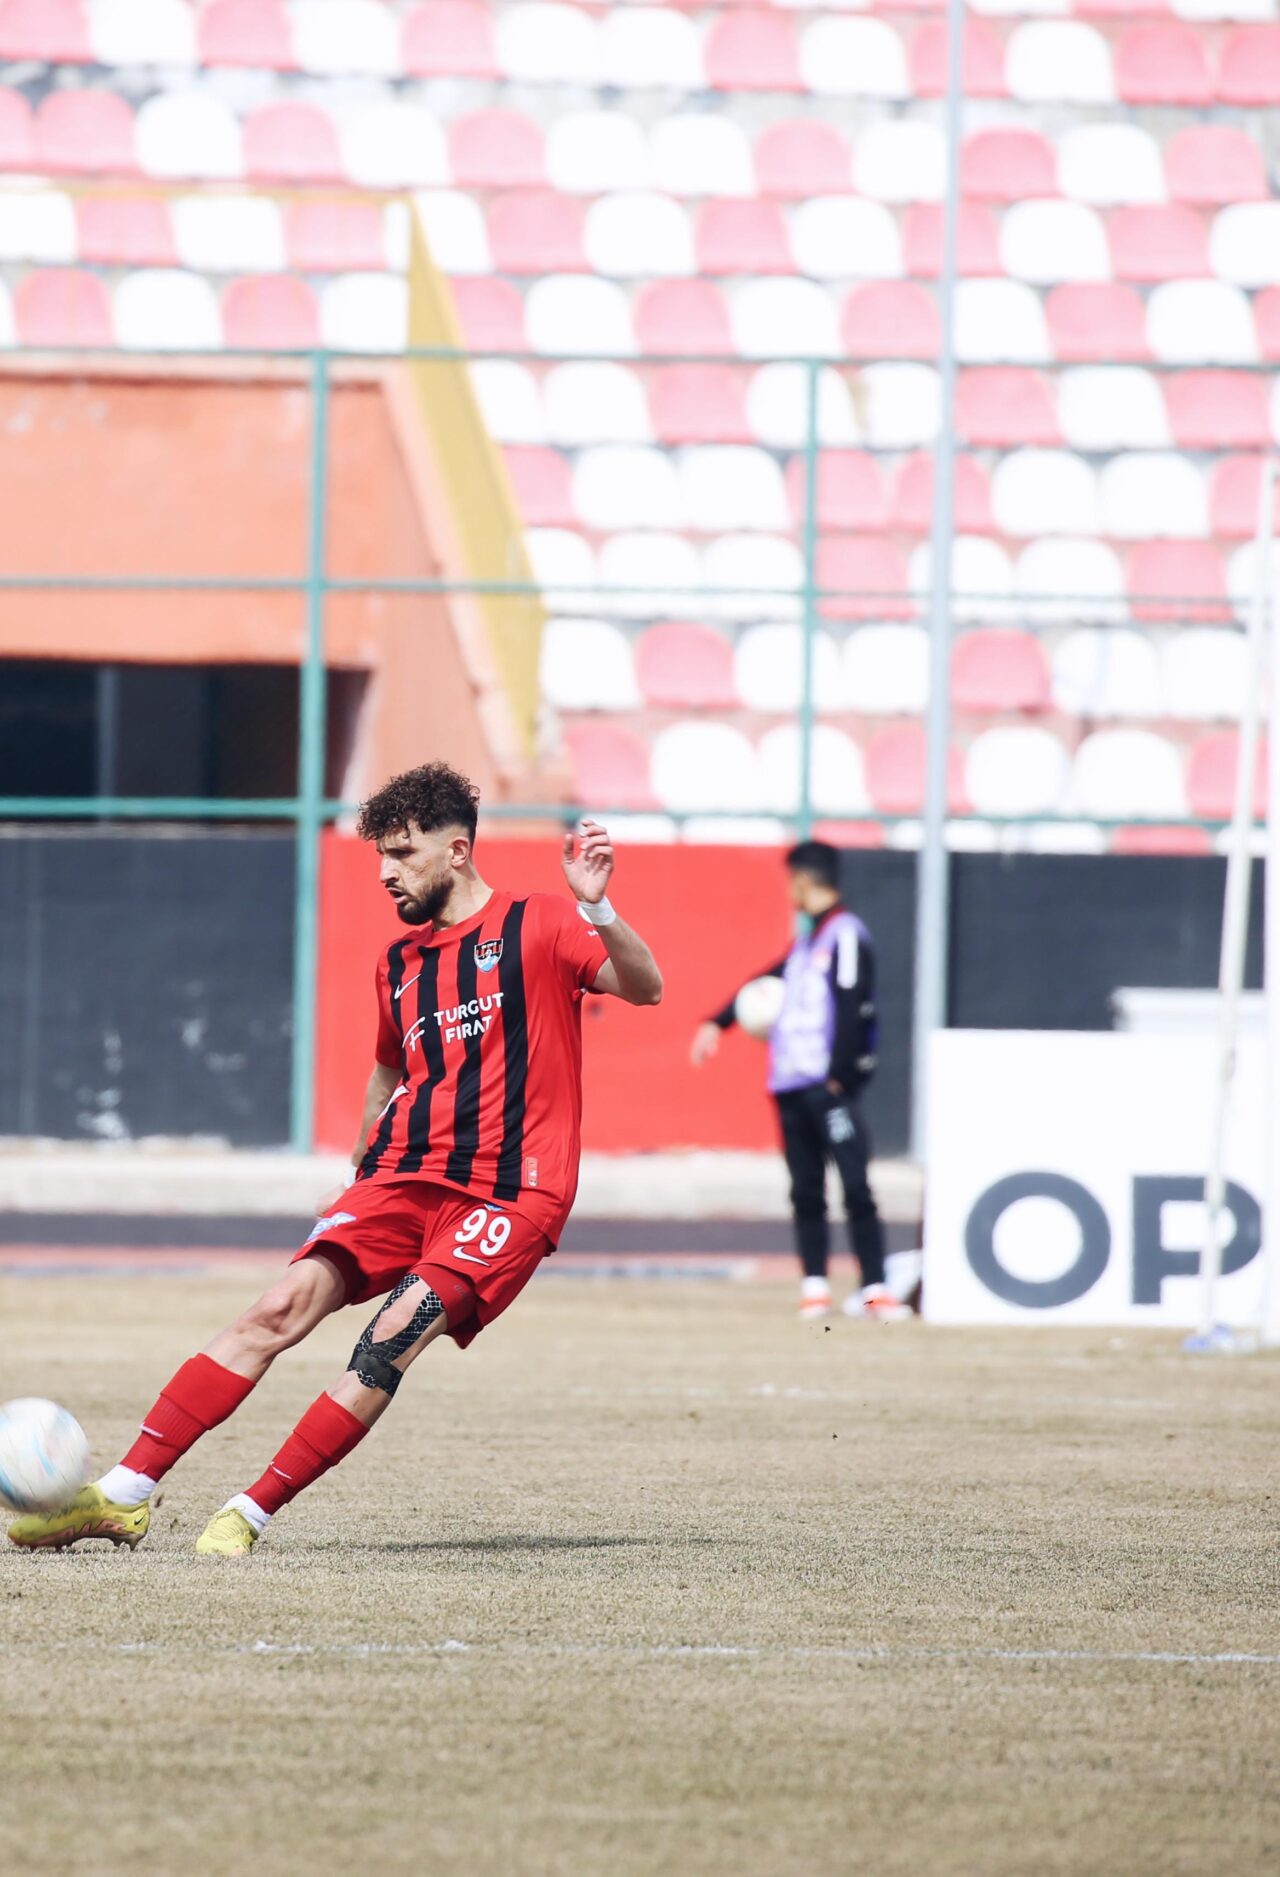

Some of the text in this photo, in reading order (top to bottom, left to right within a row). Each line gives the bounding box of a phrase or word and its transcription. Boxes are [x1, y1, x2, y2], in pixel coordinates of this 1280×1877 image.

[433, 992, 504, 1026] TURGUT
[445, 1015, 492, 1044] FIRAT
[454, 1208, 511, 1256] 99
